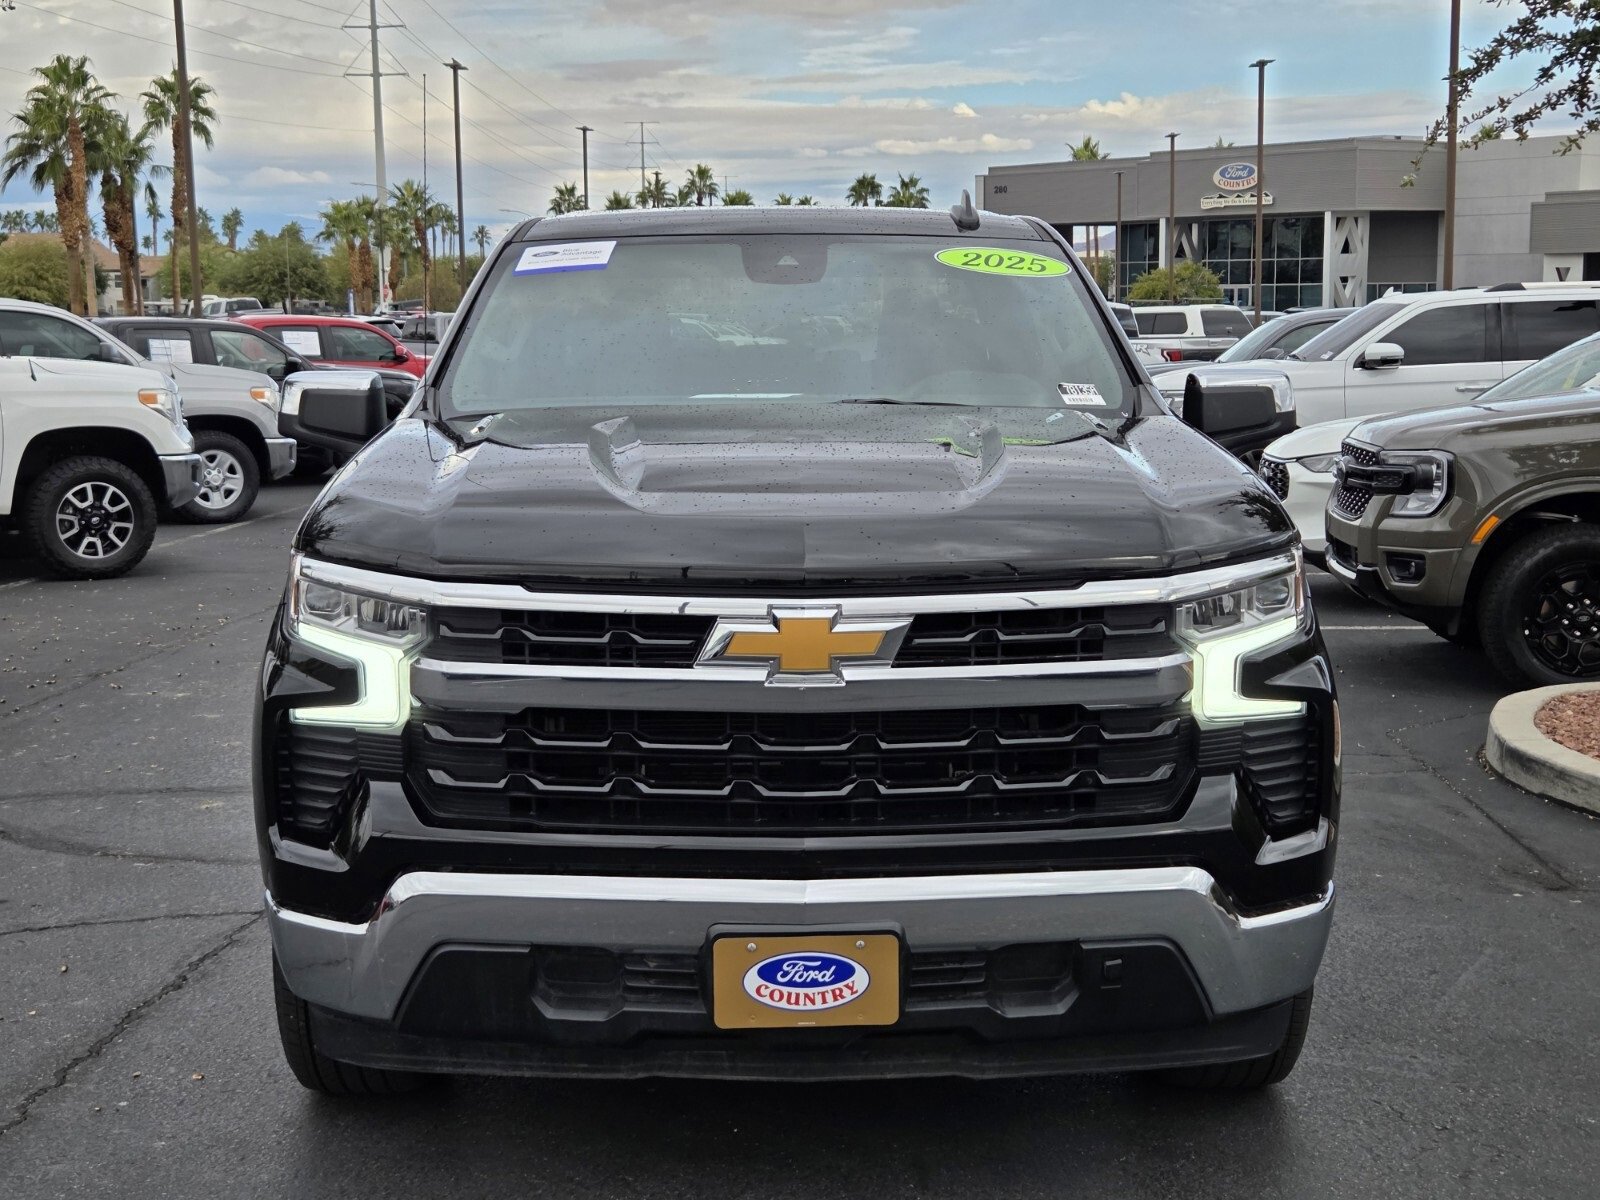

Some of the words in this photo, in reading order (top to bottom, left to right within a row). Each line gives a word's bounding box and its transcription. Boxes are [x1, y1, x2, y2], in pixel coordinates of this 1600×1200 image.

[1225, 165, 1248, 177] Ford
[994, 185, 1007, 193] 280
[1218, 176, 1256, 187] COUNTRY
[961, 252, 1048, 273] 2025
[776, 960, 836, 983] Ford
[755, 980, 858, 1006] COUNTRY
